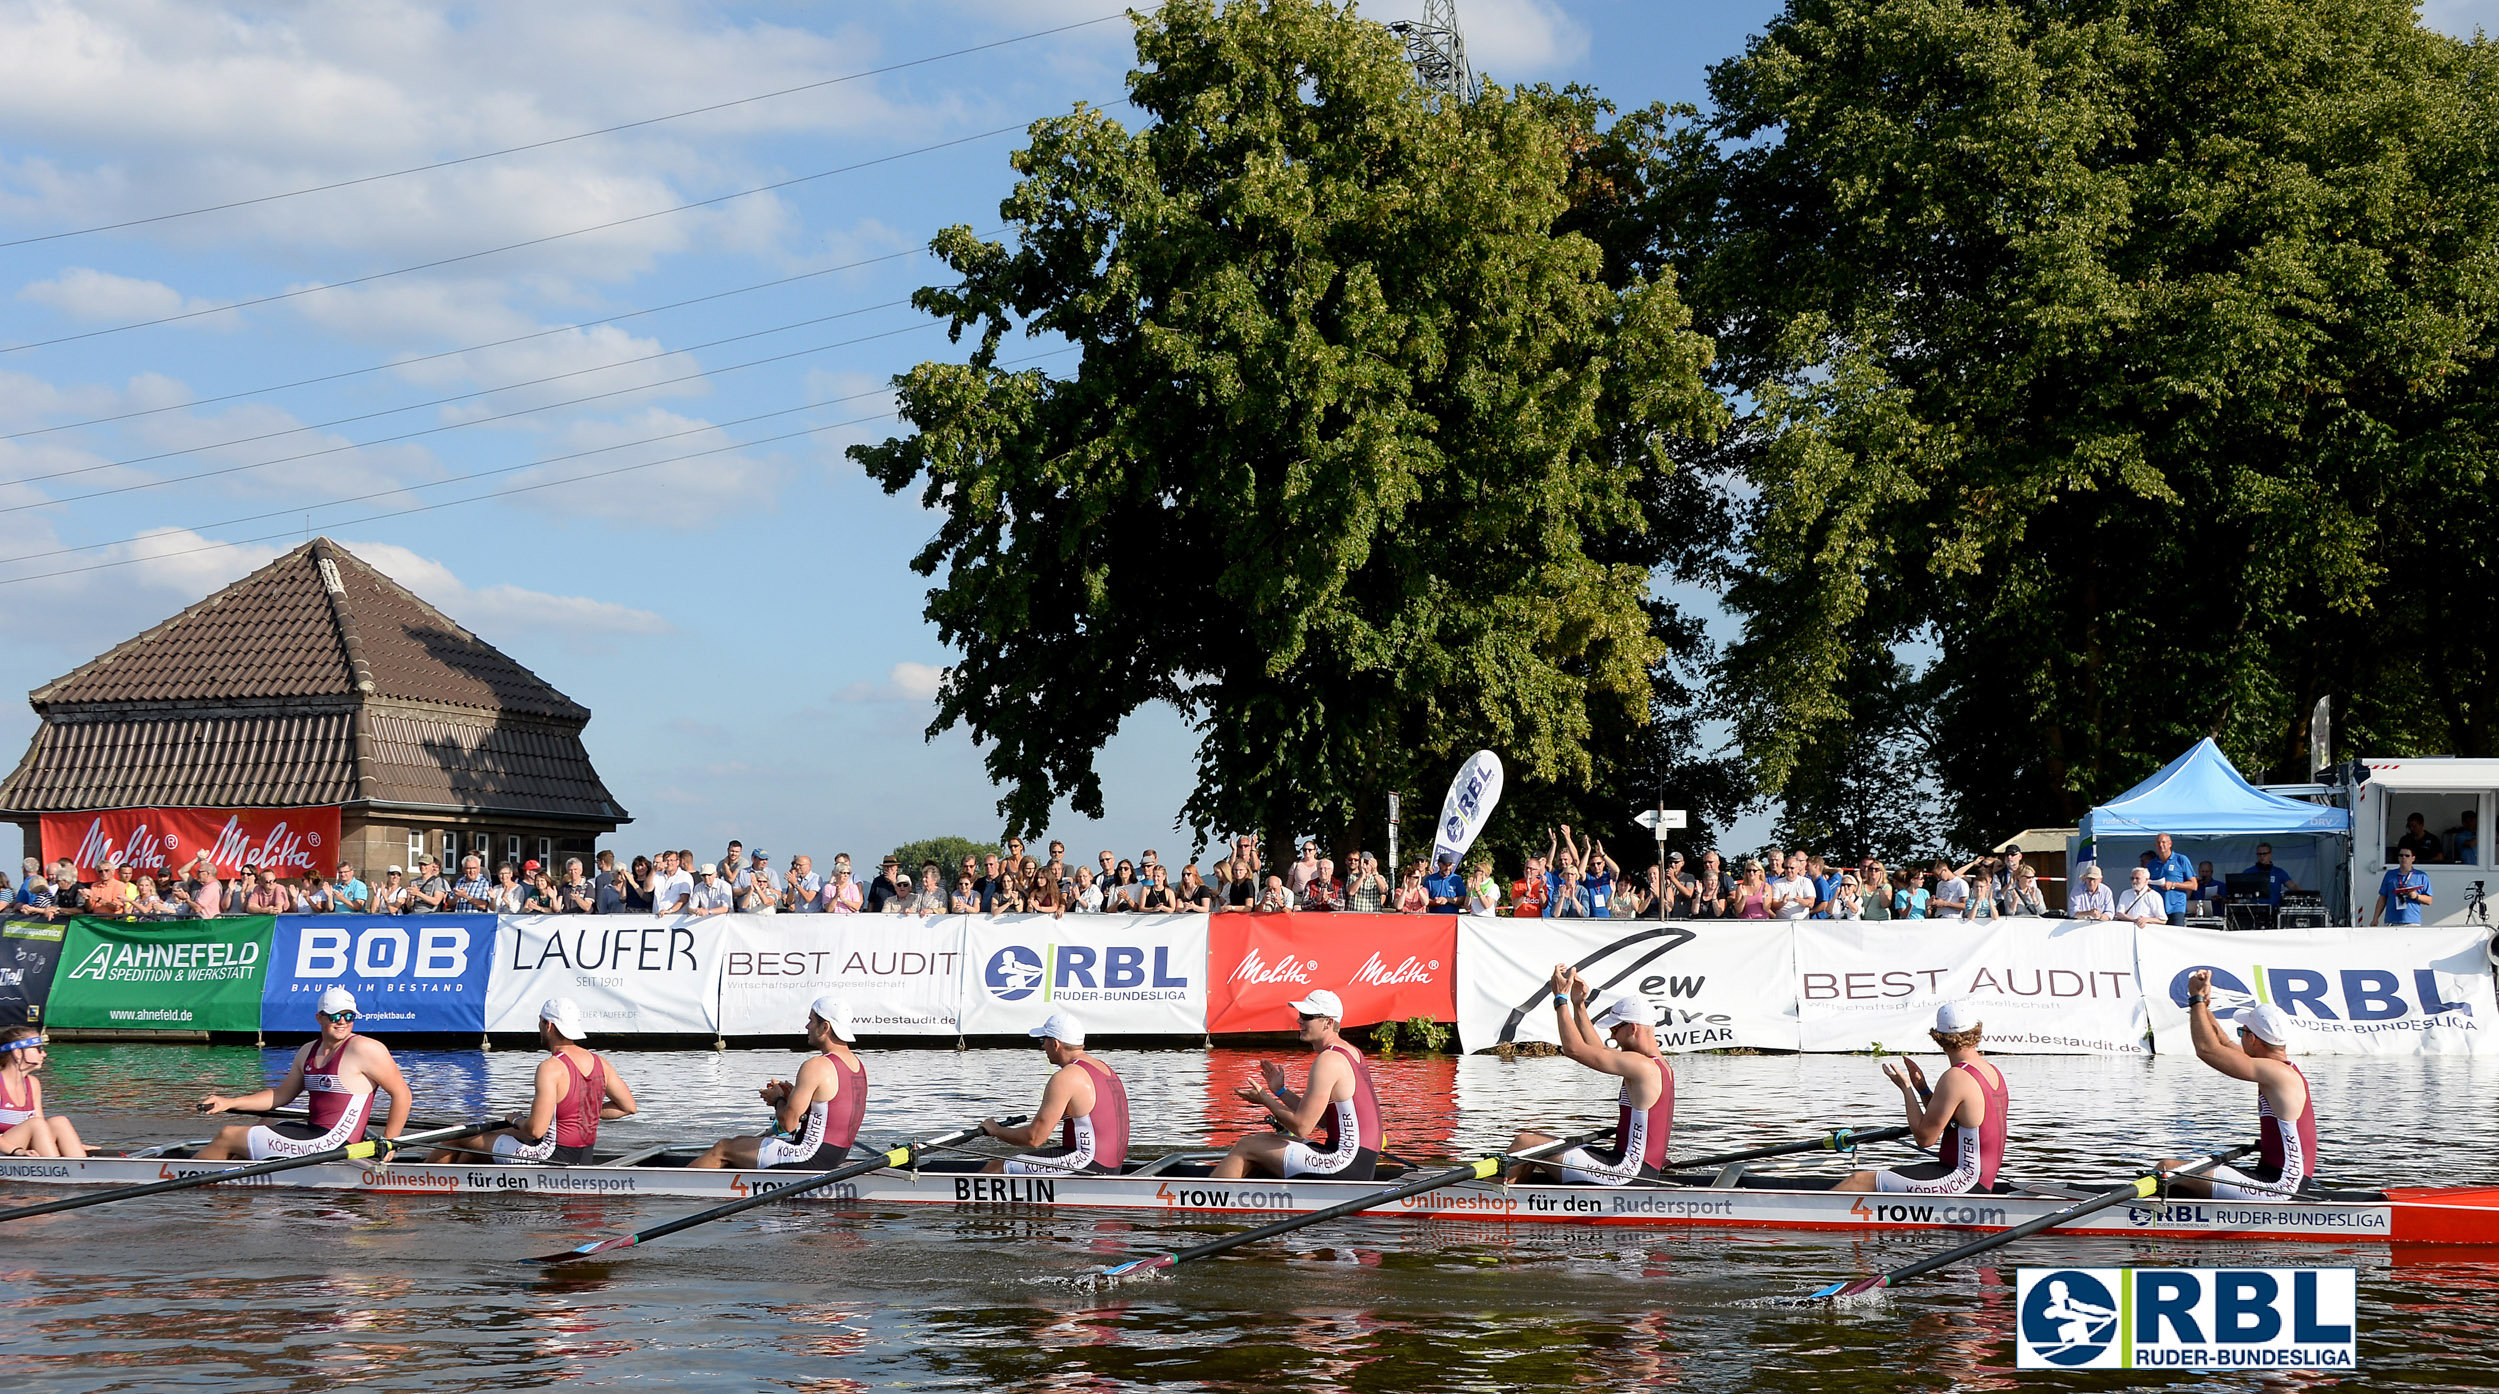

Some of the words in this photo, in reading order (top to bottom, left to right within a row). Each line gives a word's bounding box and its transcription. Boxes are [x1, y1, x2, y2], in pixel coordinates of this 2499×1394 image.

[1457, 766, 1493, 818] RBL
[113, 942, 259, 968] AHNEFELD
[294, 927, 471, 978] BOB
[512, 928, 698, 971] LAUFER
[108, 967, 175, 982] SPEDITION
[175, 968, 184, 982] &
[187, 965, 256, 982] WERKSTATT
[728, 951, 830, 976] BEST
[841, 951, 958, 975] AUDIT
[1055, 945, 1187, 988] RBL
[291, 983, 346, 992] BAUEN
[357, 983, 375, 992] IM
[387, 983, 464, 992] BESTAND
[576, 976, 597, 987] SEIT
[599, 977, 624, 988] 1901
[1803, 968, 1948, 1000] BEST
[1968, 967, 2131, 999] AUDIT
[2267, 968, 2474, 1021] RBL
[1053, 990, 1186, 1002] RUDER-BUNDESLIGA
[109, 1008, 192, 1022] www.ahnefeld.de
[851, 1015, 956, 1025] ww.bestaudit.de
[2290, 1016, 2478, 1034] UDER-BUNDESLIGA
[267, 1107, 359, 1155] KÖPENICK-ACHTER
[0, 1164, 69, 1178] BUNDESLIGA
[362, 1170, 460, 1191] Onlineshop
[466, 1171, 493, 1188] für
[496, 1172, 529, 1189] den
[537, 1173, 636, 1194] Rudersport
[954, 1177, 1055, 1203] BERLIN
[1156, 1182, 1294, 1209] 4row.com
[1400, 1192, 1518, 1216] Onlineshop
[1527, 1194, 1560, 1212] für
[1563, 1195, 1602, 1213] den
[1613, 1196, 1733, 1219] Rudersport
[1850, 1196, 2006, 1225] 4row.com
[2157, 1205, 2210, 1223] RBL
[2216, 1209, 2386, 1228] RUDER-BUNDESLIGA
